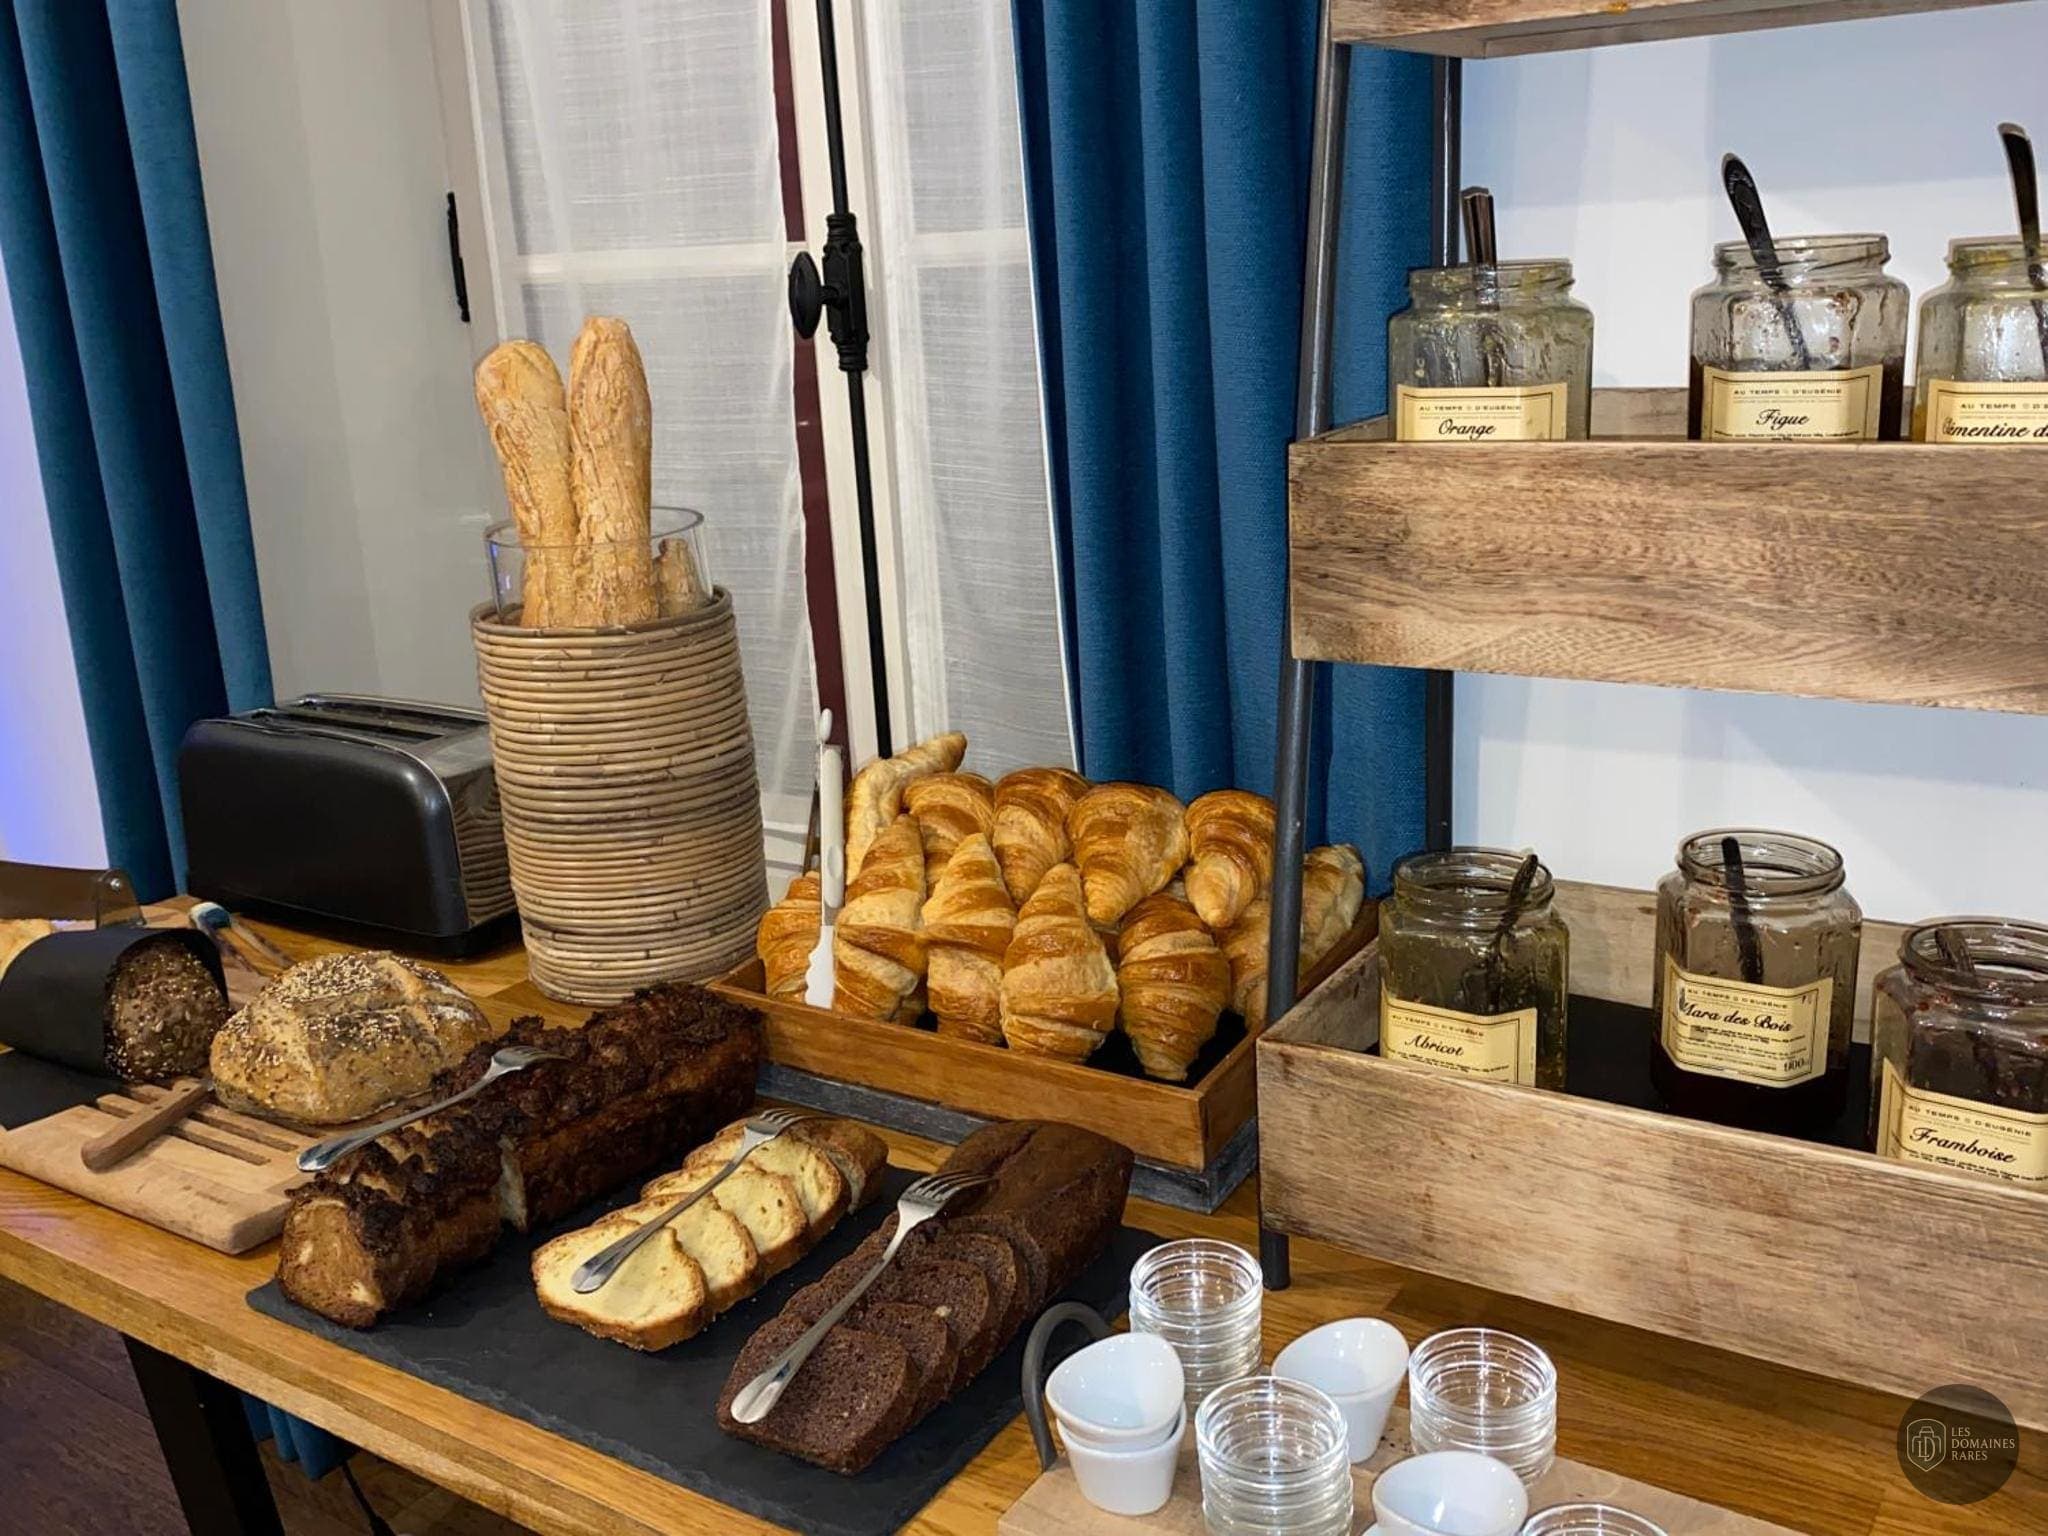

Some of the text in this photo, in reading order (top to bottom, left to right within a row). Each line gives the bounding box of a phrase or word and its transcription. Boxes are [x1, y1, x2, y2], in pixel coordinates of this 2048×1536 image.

[1438, 418, 1496, 440] Orange
[1756, 409, 1810, 430] Figue
[1724, 1010, 1751, 1026] des
[1754, 1014, 1793, 1032] Bois
[1405, 1034, 1464, 1057] Abricot
[1909, 1127, 2016, 1163] Framboise
